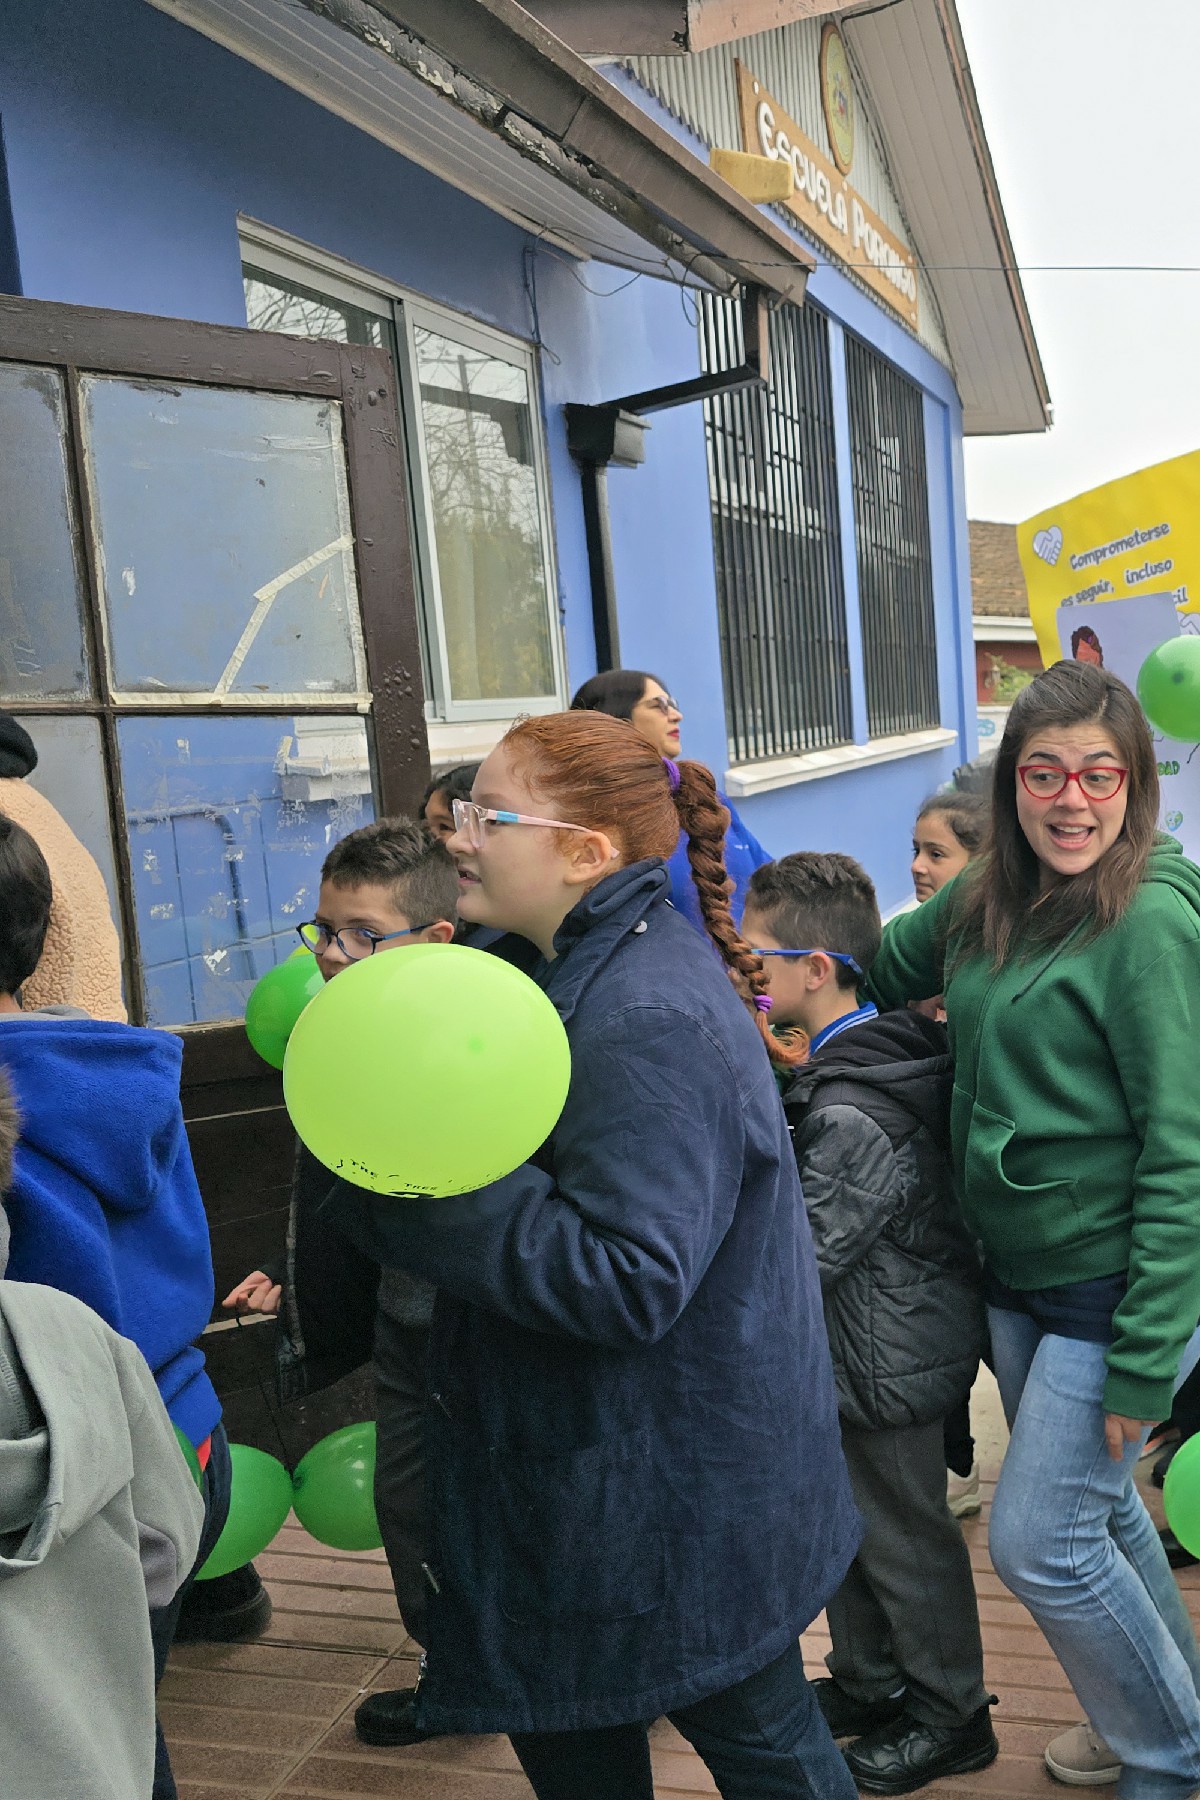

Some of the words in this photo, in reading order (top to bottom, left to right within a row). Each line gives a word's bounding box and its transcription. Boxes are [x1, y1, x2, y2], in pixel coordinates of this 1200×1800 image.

[759, 101, 848, 235] ESCUELA
[1070, 523, 1170, 569] Comprometerse
[1126, 559, 1172, 584] incluso
